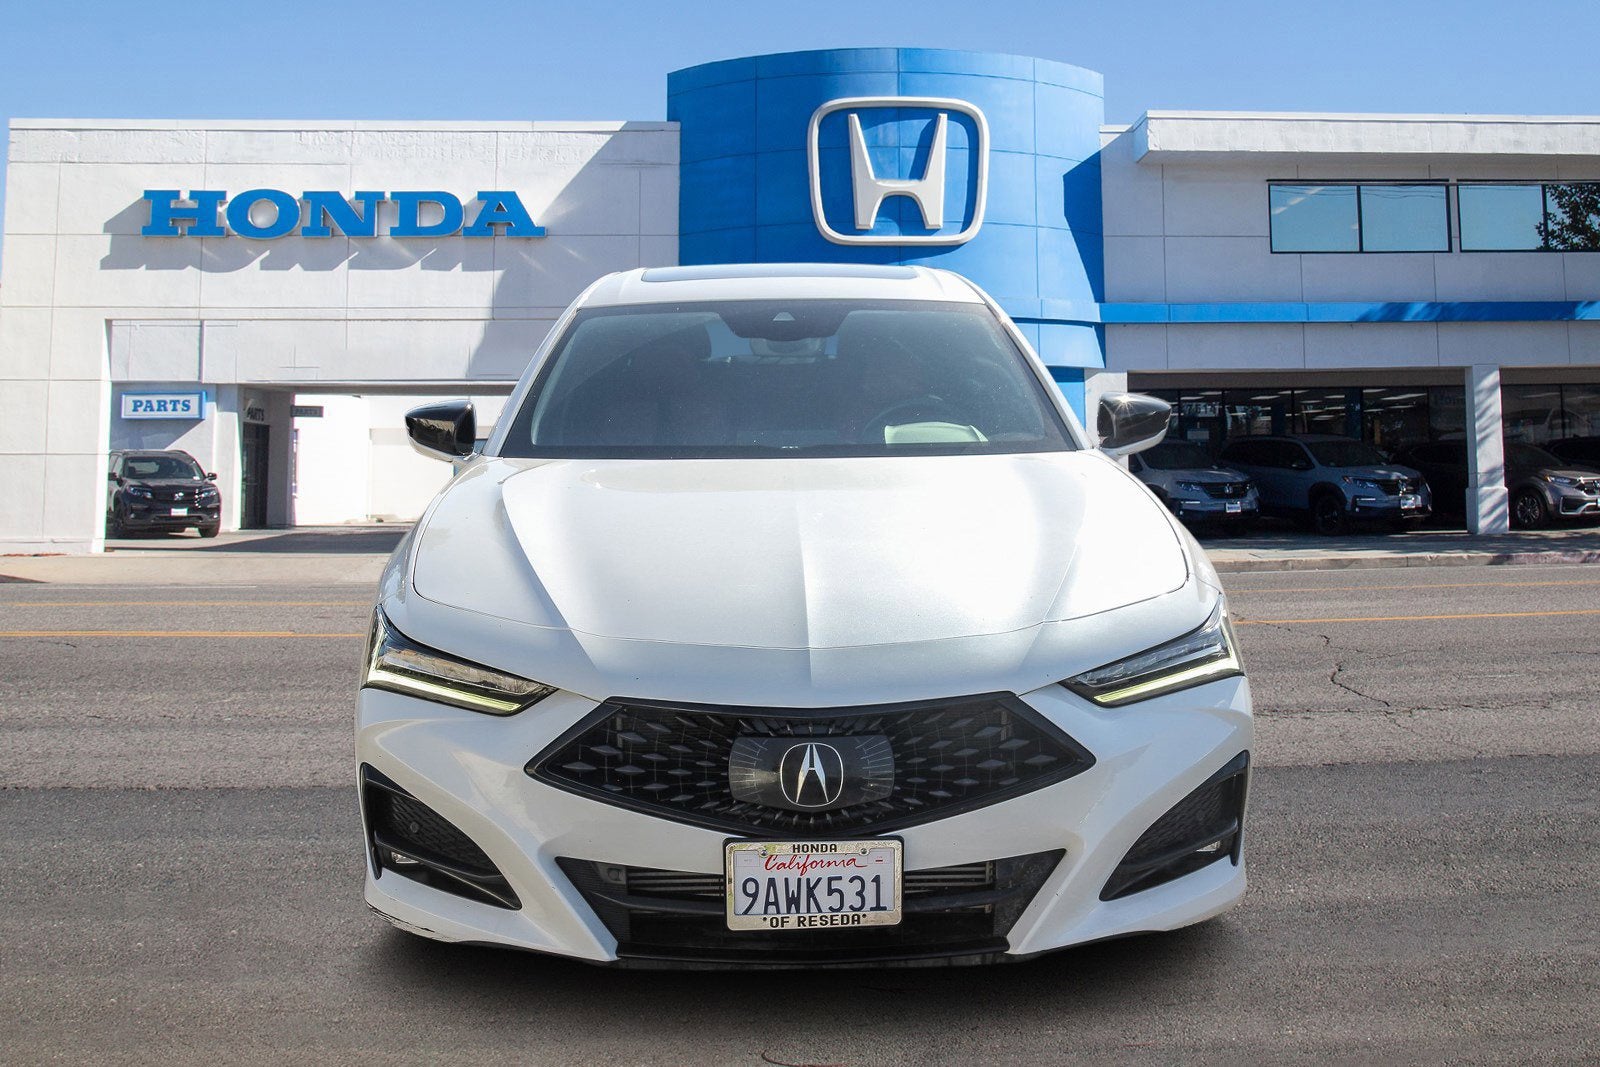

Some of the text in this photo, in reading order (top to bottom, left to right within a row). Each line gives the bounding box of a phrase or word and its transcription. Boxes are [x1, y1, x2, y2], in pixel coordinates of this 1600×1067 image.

[141, 189, 546, 239] HONDA
[132, 399, 191, 412] PARTS
[792, 843, 837, 853] HONDA
[764, 854, 868, 876] California
[741, 874, 888, 916] 9AWK531
[769, 914, 861, 928] OF RESEDA
